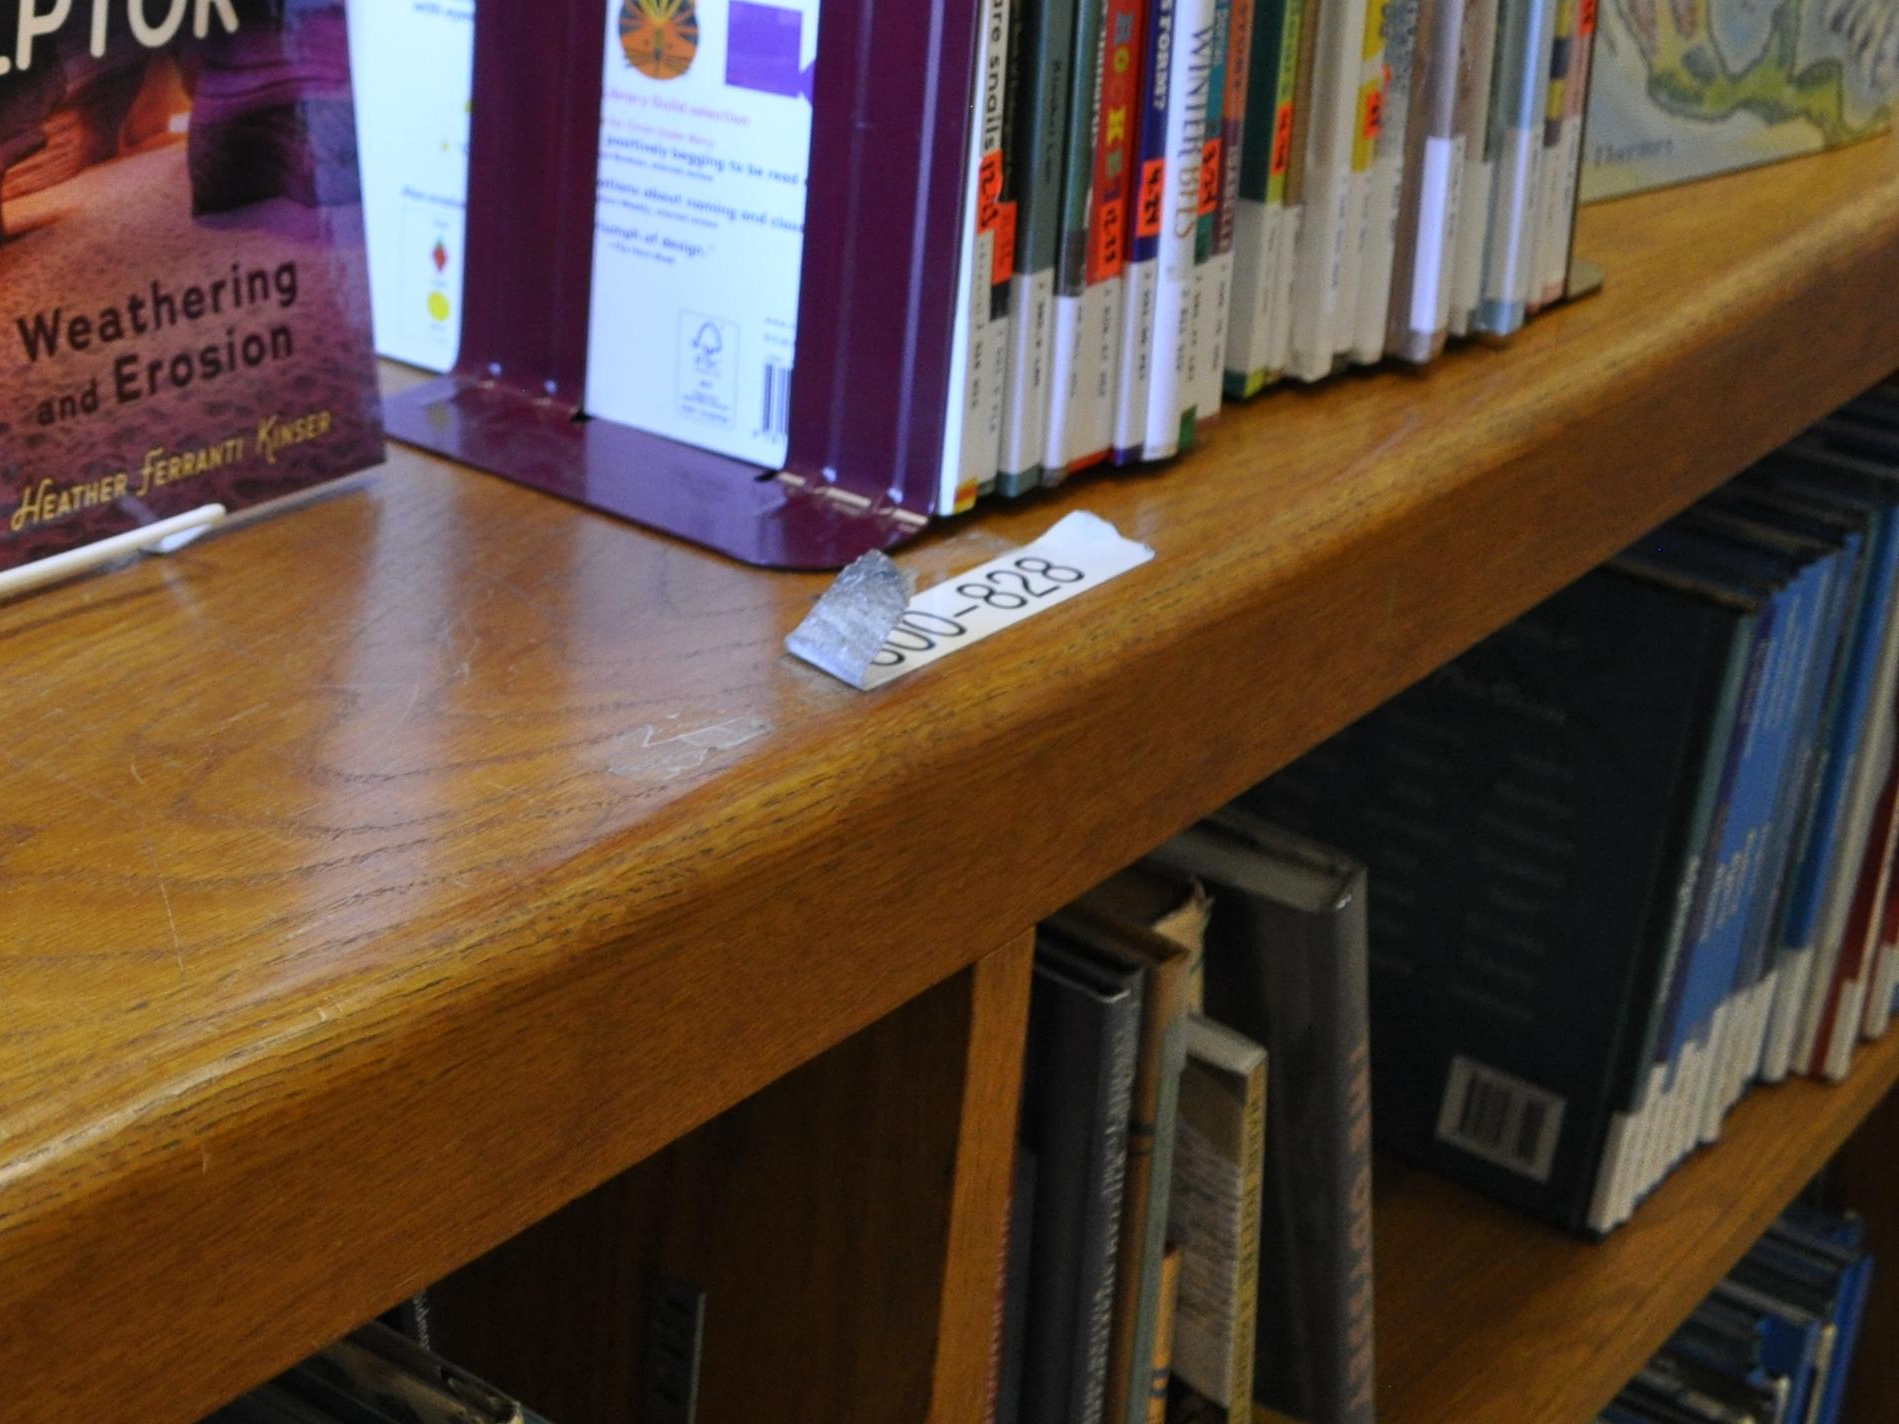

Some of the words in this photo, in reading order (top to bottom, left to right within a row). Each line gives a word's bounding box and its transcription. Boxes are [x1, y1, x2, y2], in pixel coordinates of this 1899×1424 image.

[984, 55, 1001, 149] snails
[1154, 16, 1173, 111] FORM?
[1177, 26, 1213, 159] WINTER
[673, 147, 727, 171] begging
[15, 259, 299, 363] Weathering
[36, 377, 100, 426] and
[113, 324, 295, 405] Erosion
[10, 474, 128, 532] HEATHER
[136, 437, 246, 497] FERRANTI
[256, 410, 333, 466] KINSER
